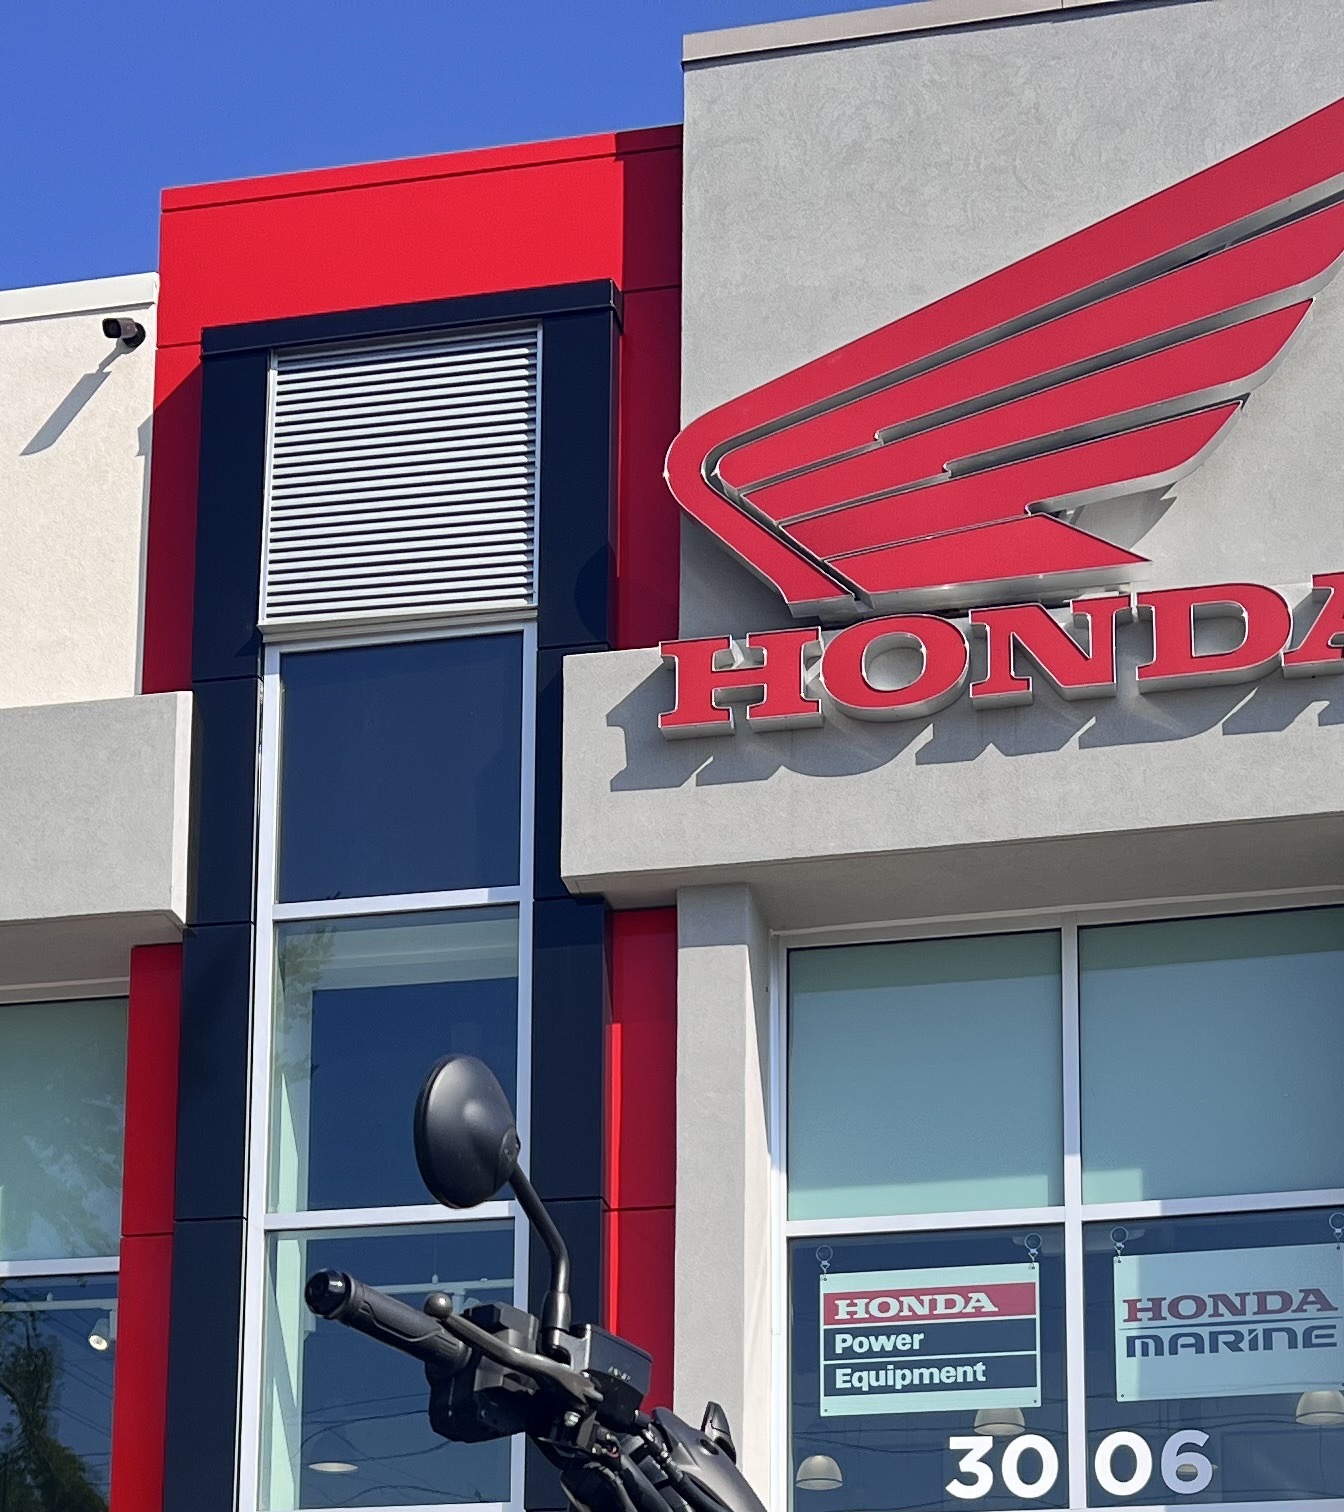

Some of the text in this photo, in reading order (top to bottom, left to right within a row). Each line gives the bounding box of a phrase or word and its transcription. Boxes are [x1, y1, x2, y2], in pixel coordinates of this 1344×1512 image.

[833, 1290, 999, 1322] HONDA
[1121, 1287, 1339, 1324] HONDA
[835, 1328, 925, 1354] Power
[1125, 1324, 1339, 1358] MARINE
[834, 1361, 987, 1392] Equipment
